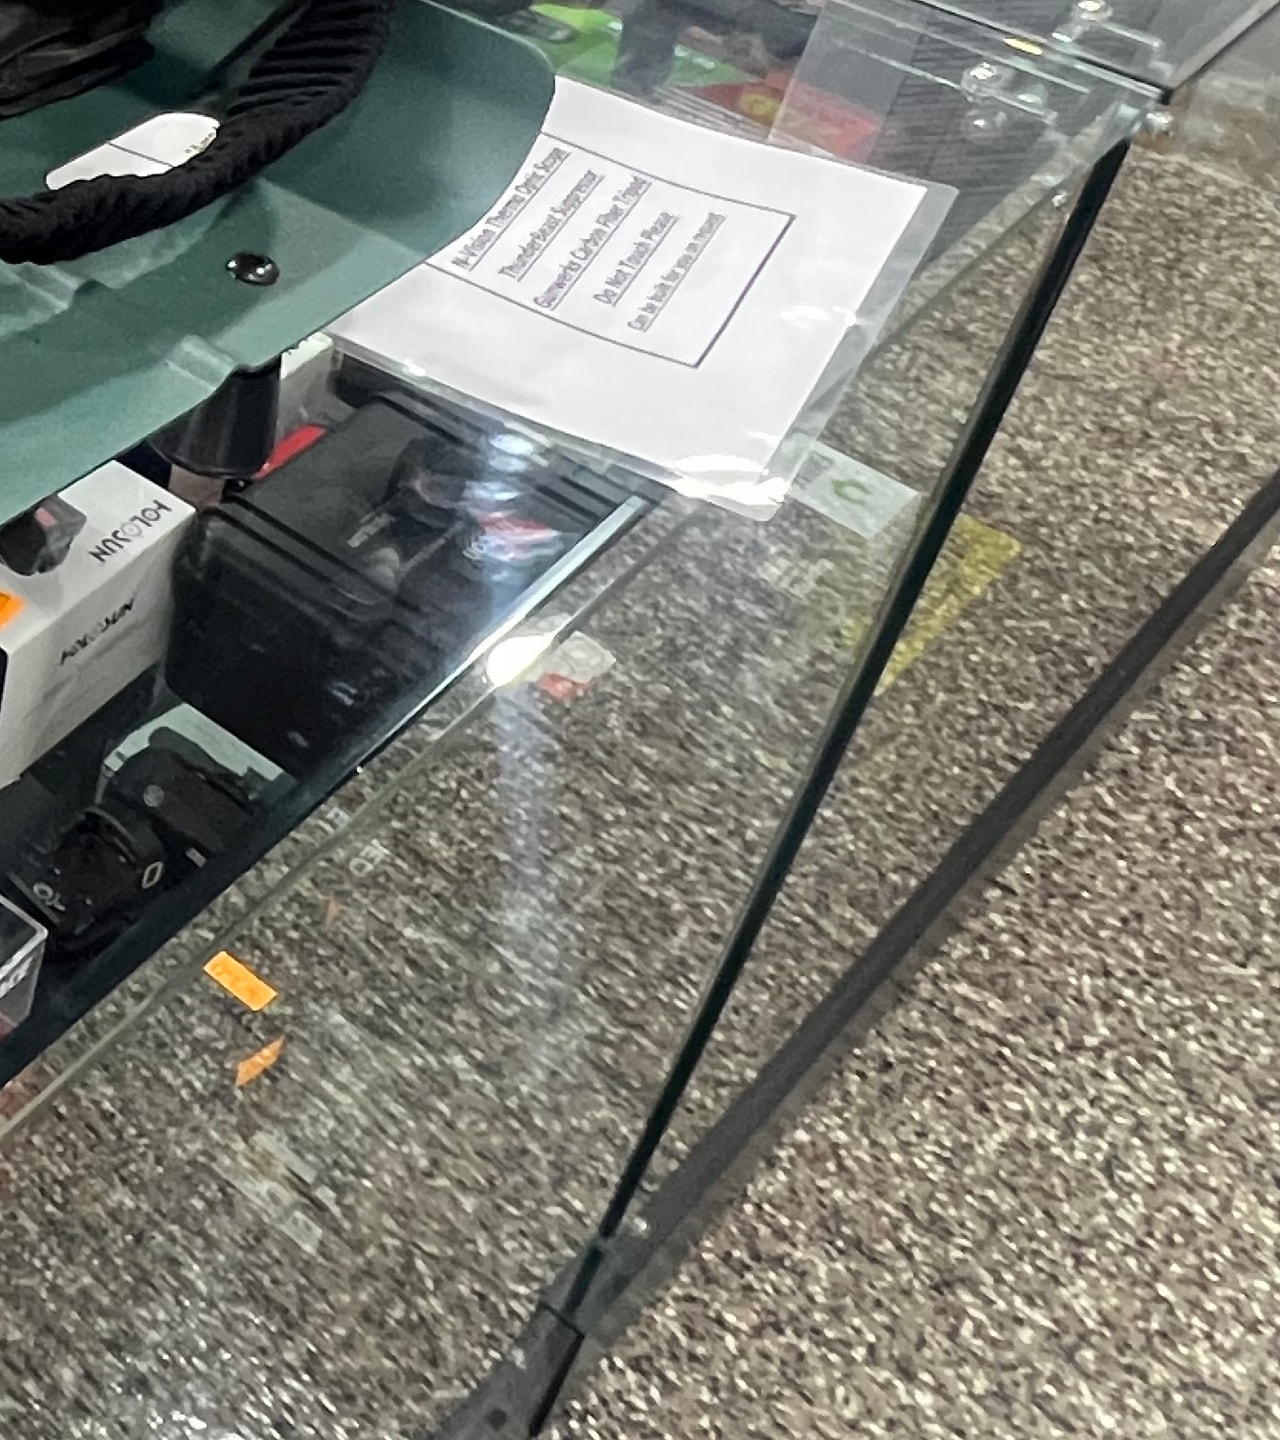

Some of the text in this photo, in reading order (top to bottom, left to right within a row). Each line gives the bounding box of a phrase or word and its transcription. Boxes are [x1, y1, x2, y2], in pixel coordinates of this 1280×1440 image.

[605, 266, 631, 288] Not
[620, 242, 650, 271] Touch
[89, 499, 172, 563] HOLOSUN
